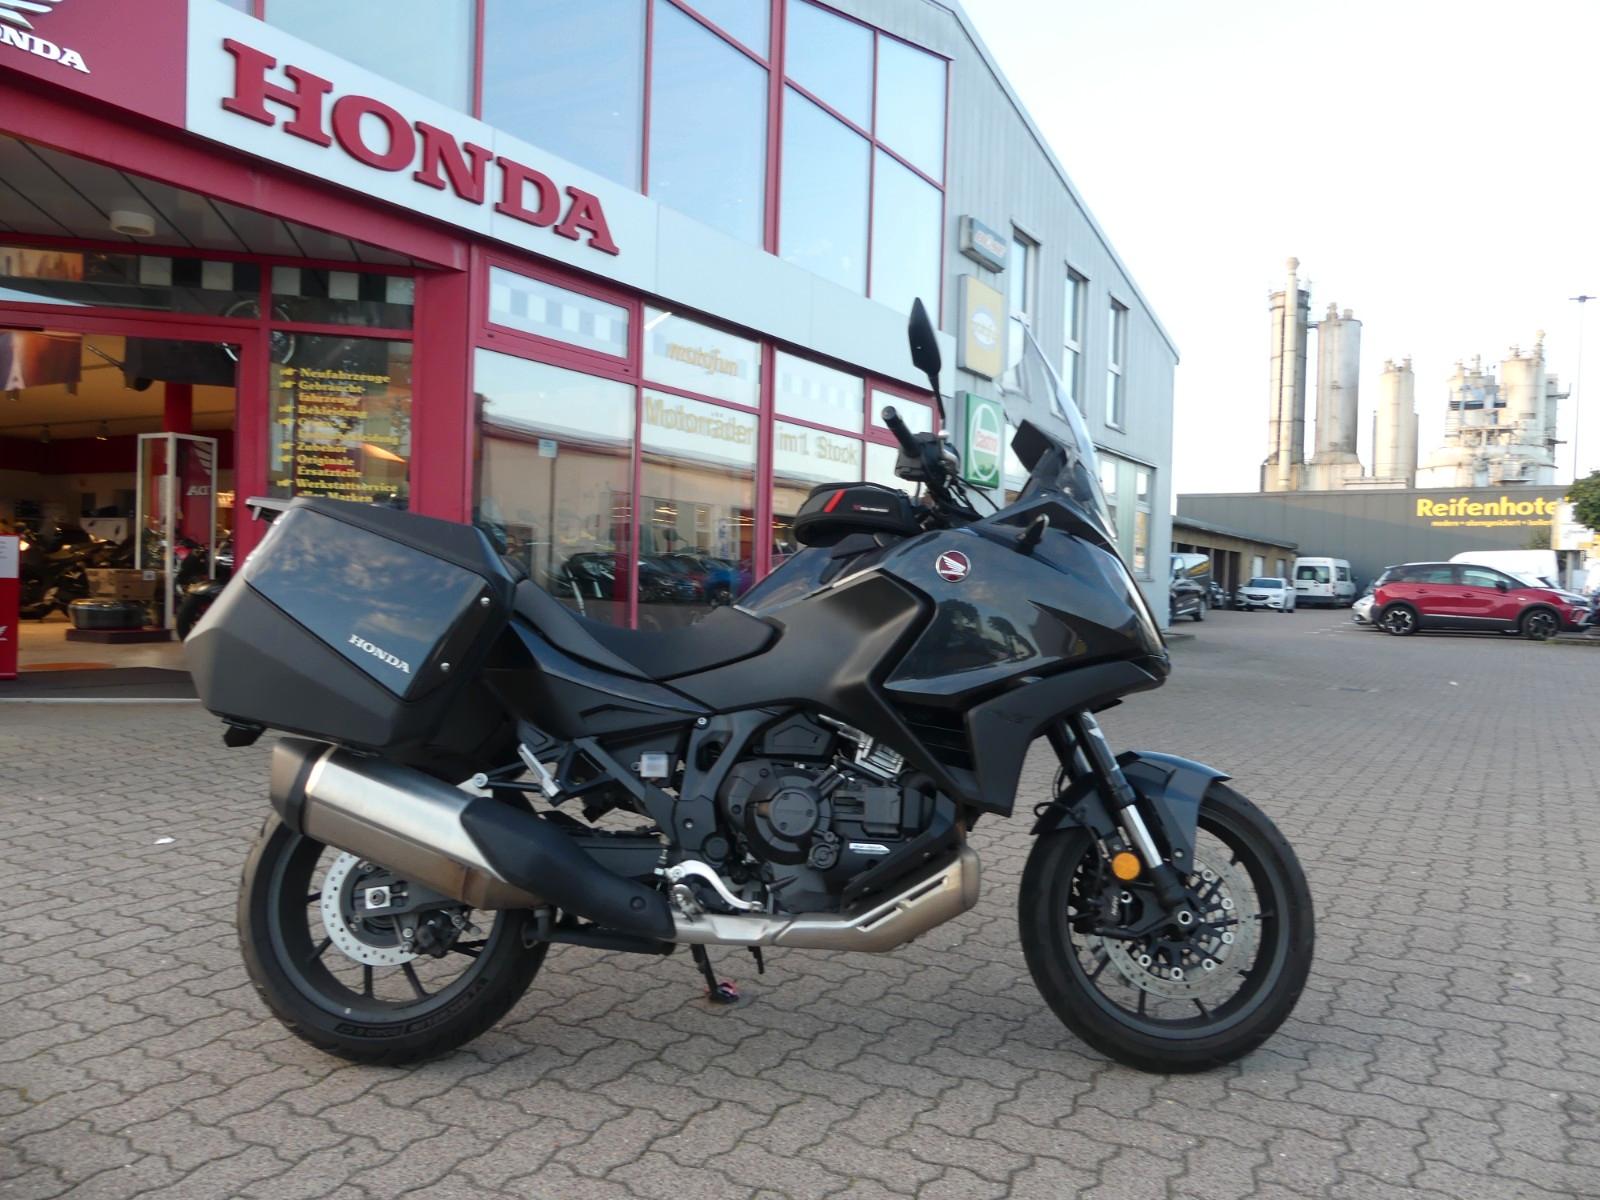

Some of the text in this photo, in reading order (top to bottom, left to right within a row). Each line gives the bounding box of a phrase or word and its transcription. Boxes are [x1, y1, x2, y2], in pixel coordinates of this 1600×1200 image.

[0, 24, 91, 74] NDA
[222, 38, 620, 256] HONDA
[299, 367, 391, 384] Neufahrzeuge
[297, 404, 368, 420] Bekleidung
[645, 396, 753, 445] Motorräder
[296, 454, 355, 466] Originale
[776, 425, 797, 453] im
[816, 436, 859, 466] Stock
[297, 465, 362, 478] Ersatzteile
[1416, 496, 1570, 517] Reifenhote
[348, 633, 411, 674] HONDA
